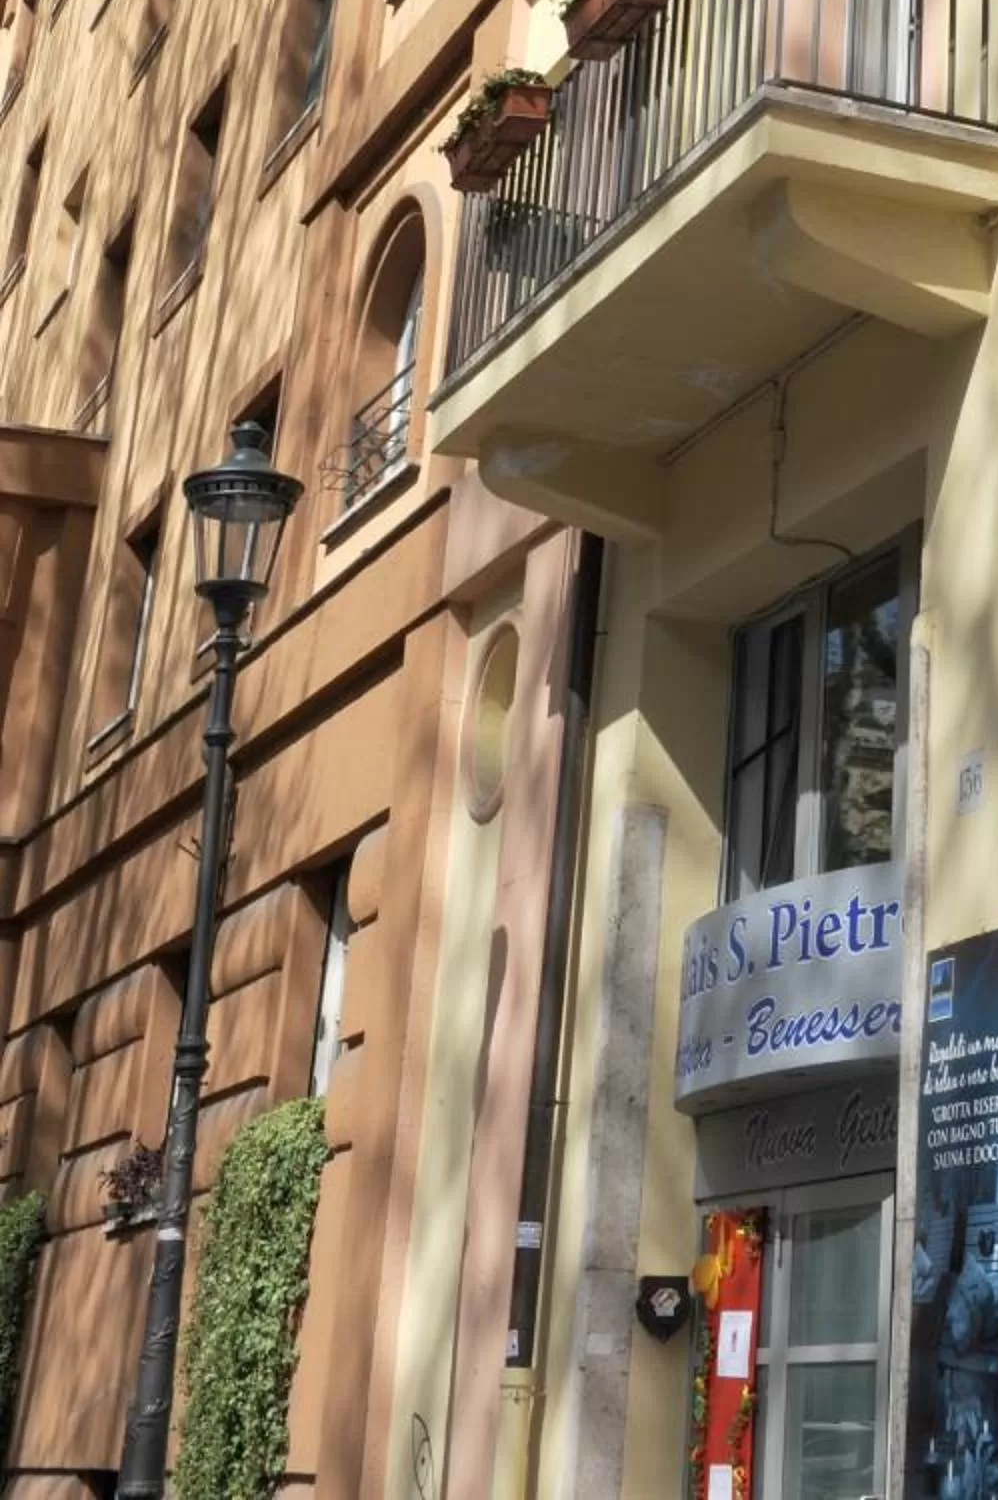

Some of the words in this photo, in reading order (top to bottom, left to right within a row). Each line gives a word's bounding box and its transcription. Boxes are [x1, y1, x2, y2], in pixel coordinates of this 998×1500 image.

[727, 915, 756, 982] S.
[766, 893, 905, 969] Pietr
[927, 1127, 949, 1149] CON
[950, 1120, 985, 1143] BAGNO
[933, 1149, 965, 1171] SAUNA
